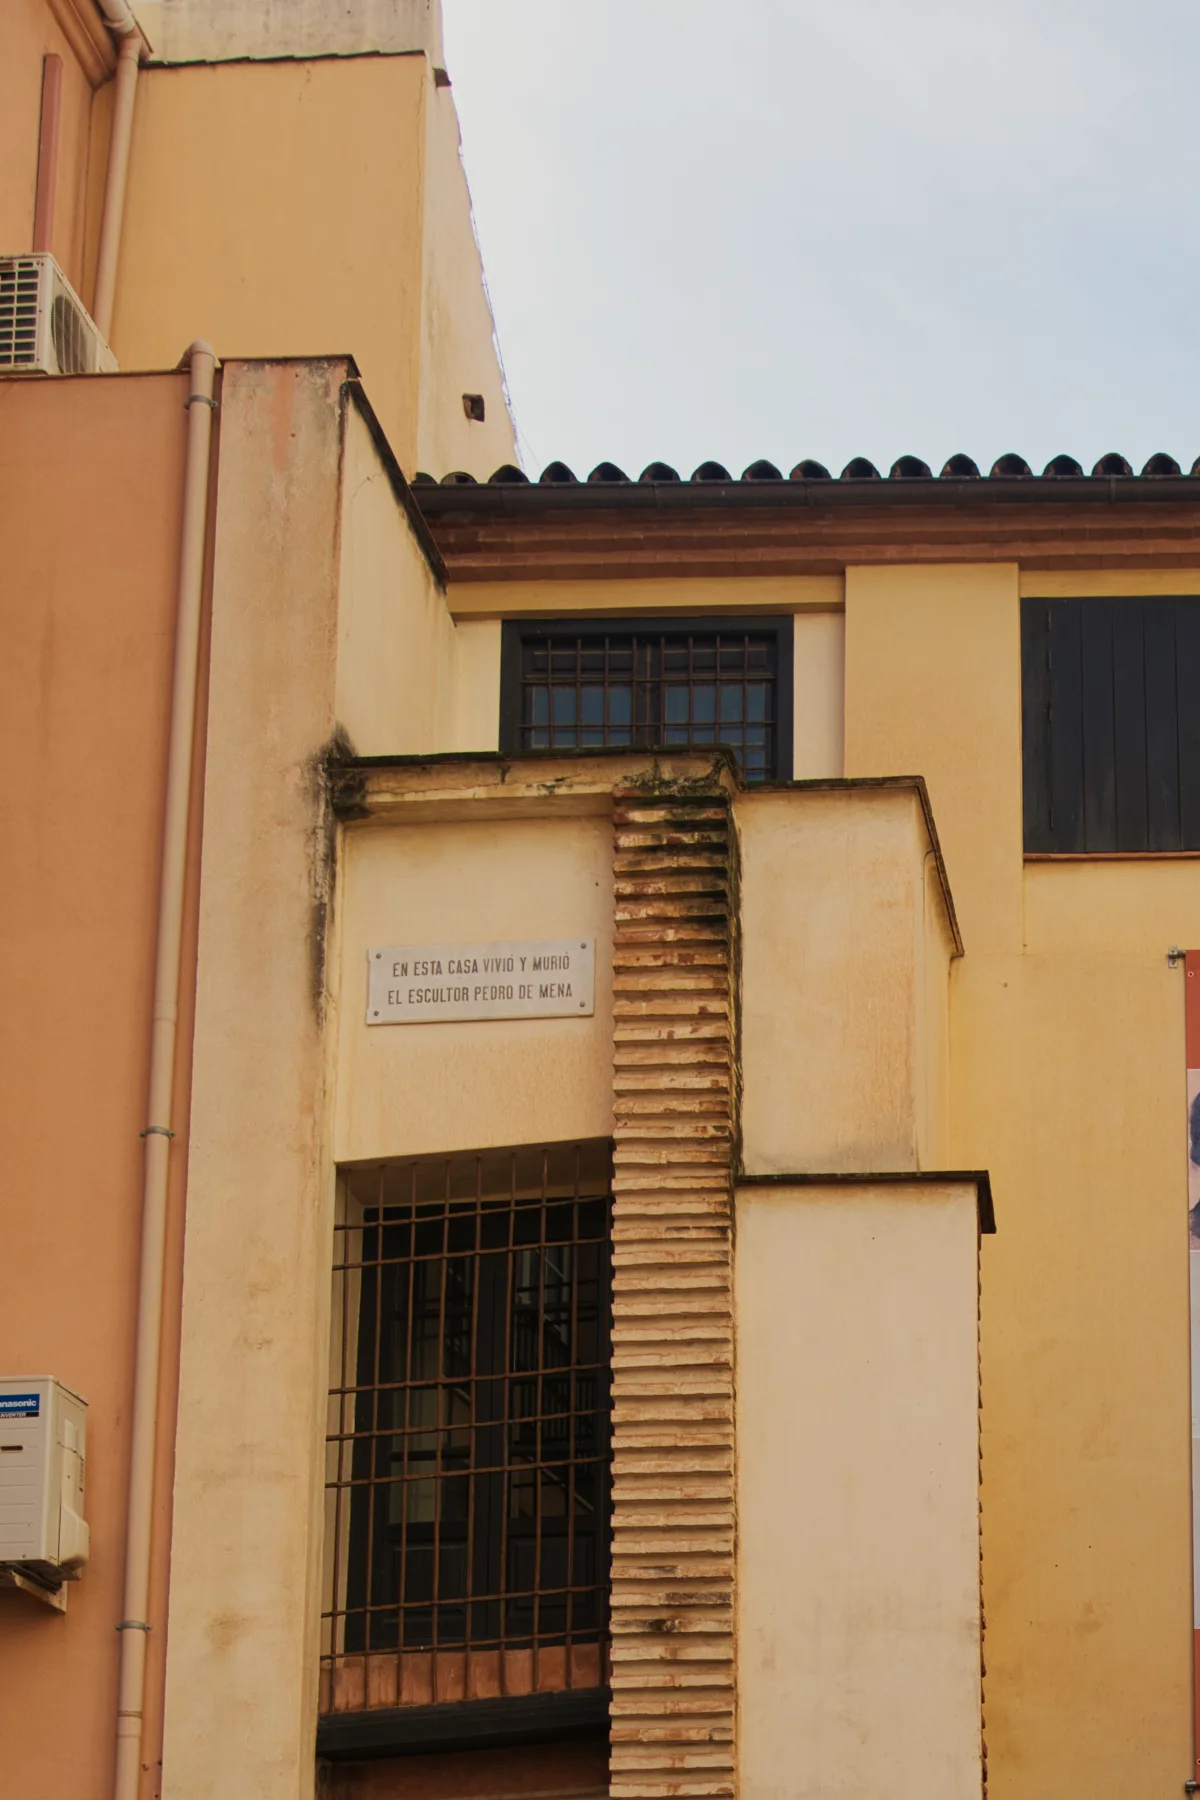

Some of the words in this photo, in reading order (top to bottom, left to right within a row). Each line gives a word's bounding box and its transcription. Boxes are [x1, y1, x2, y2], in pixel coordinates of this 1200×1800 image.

[393, 962, 408, 977] EN
[414, 960, 442, 976] ESTA
[448, 959, 478, 975] CASA
[483, 954, 514, 973] VIVIÓ
[521, 957, 527, 971] Y
[533, 952, 569, 972] MURIÓ
[388, 990, 402, 1004] EL
[408, 986, 469, 1004] ESCULTOR
[474, 985, 513, 1001] PEDRO
[519, 984, 532, 999] DE
[539, 983, 572, 999] MENA
[0, 1399, 36, 1407] nasonic
